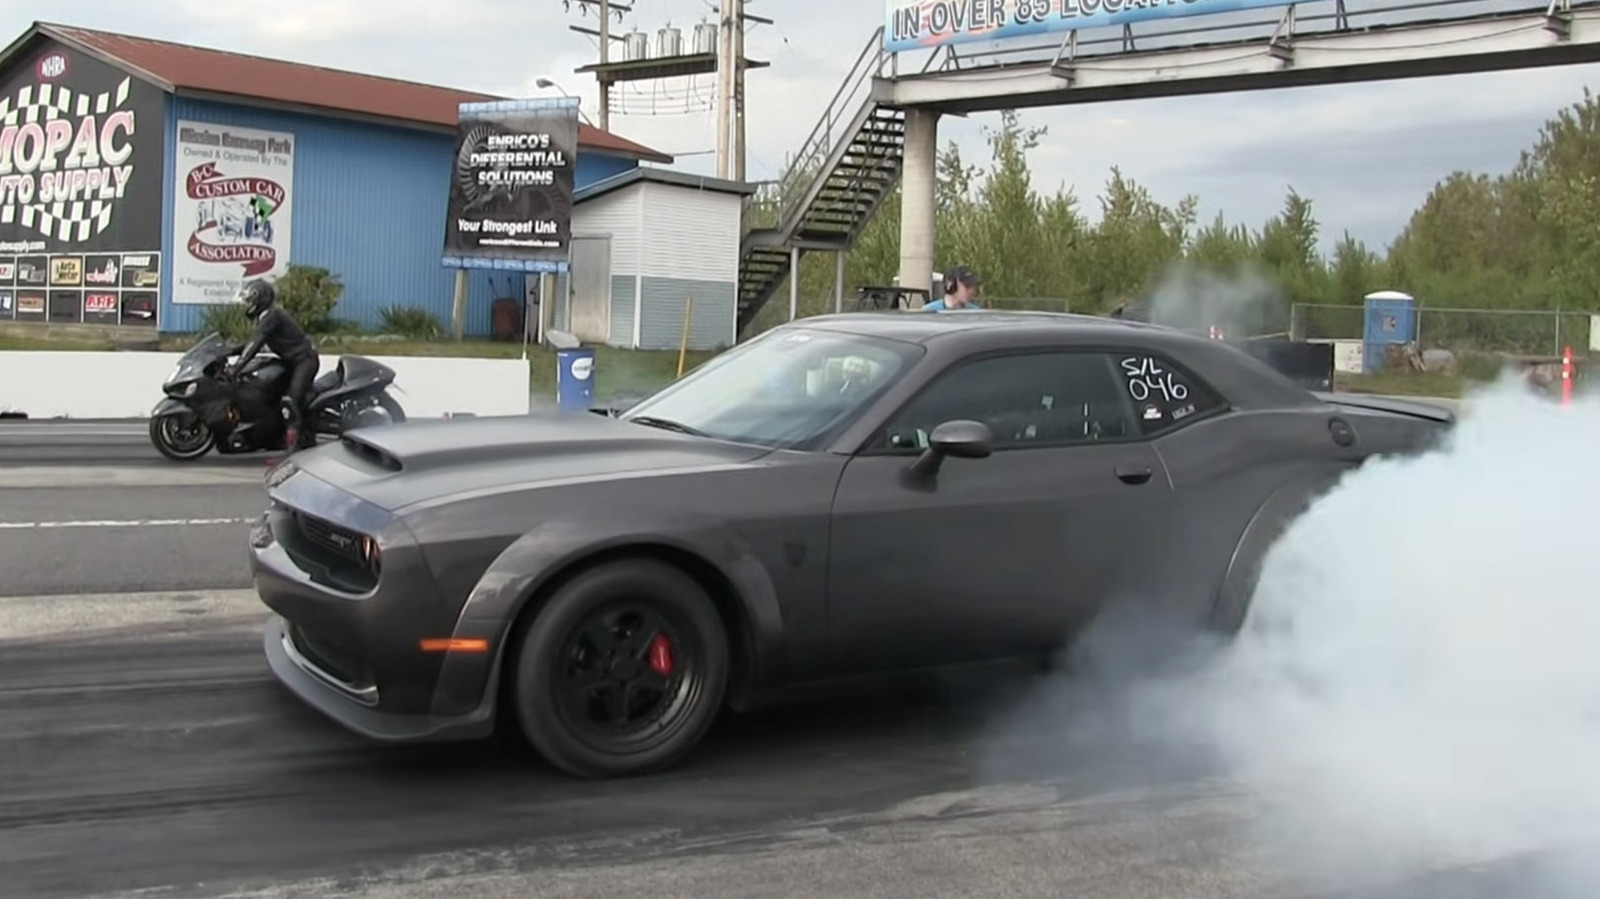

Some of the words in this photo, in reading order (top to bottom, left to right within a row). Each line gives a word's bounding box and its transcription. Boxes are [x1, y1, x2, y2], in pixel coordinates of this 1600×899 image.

[893, 6, 921, 40] IN
[928, 0, 1004, 35] OVER
[42, 56, 65, 77] NHRA
[488, 134, 549, 149] ENRICO'S
[470, 151, 565, 166] DIFFERENTIAL
[39, 165, 133, 203] SUPPLY
[478, 171, 553, 185] SOLUTIONS
[195, 179, 250, 197] CUSTOM
[256, 181, 283, 202] CAR
[458, 219, 480, 231] Your
[482, 219, 532, 236] Strongest
[534, 220, 557, 233] Link
[189, 242, 274, 259] ASSOCIATION
[86, 295, 117, 308] ARP
[1129, 373, 1188, 401] 046
